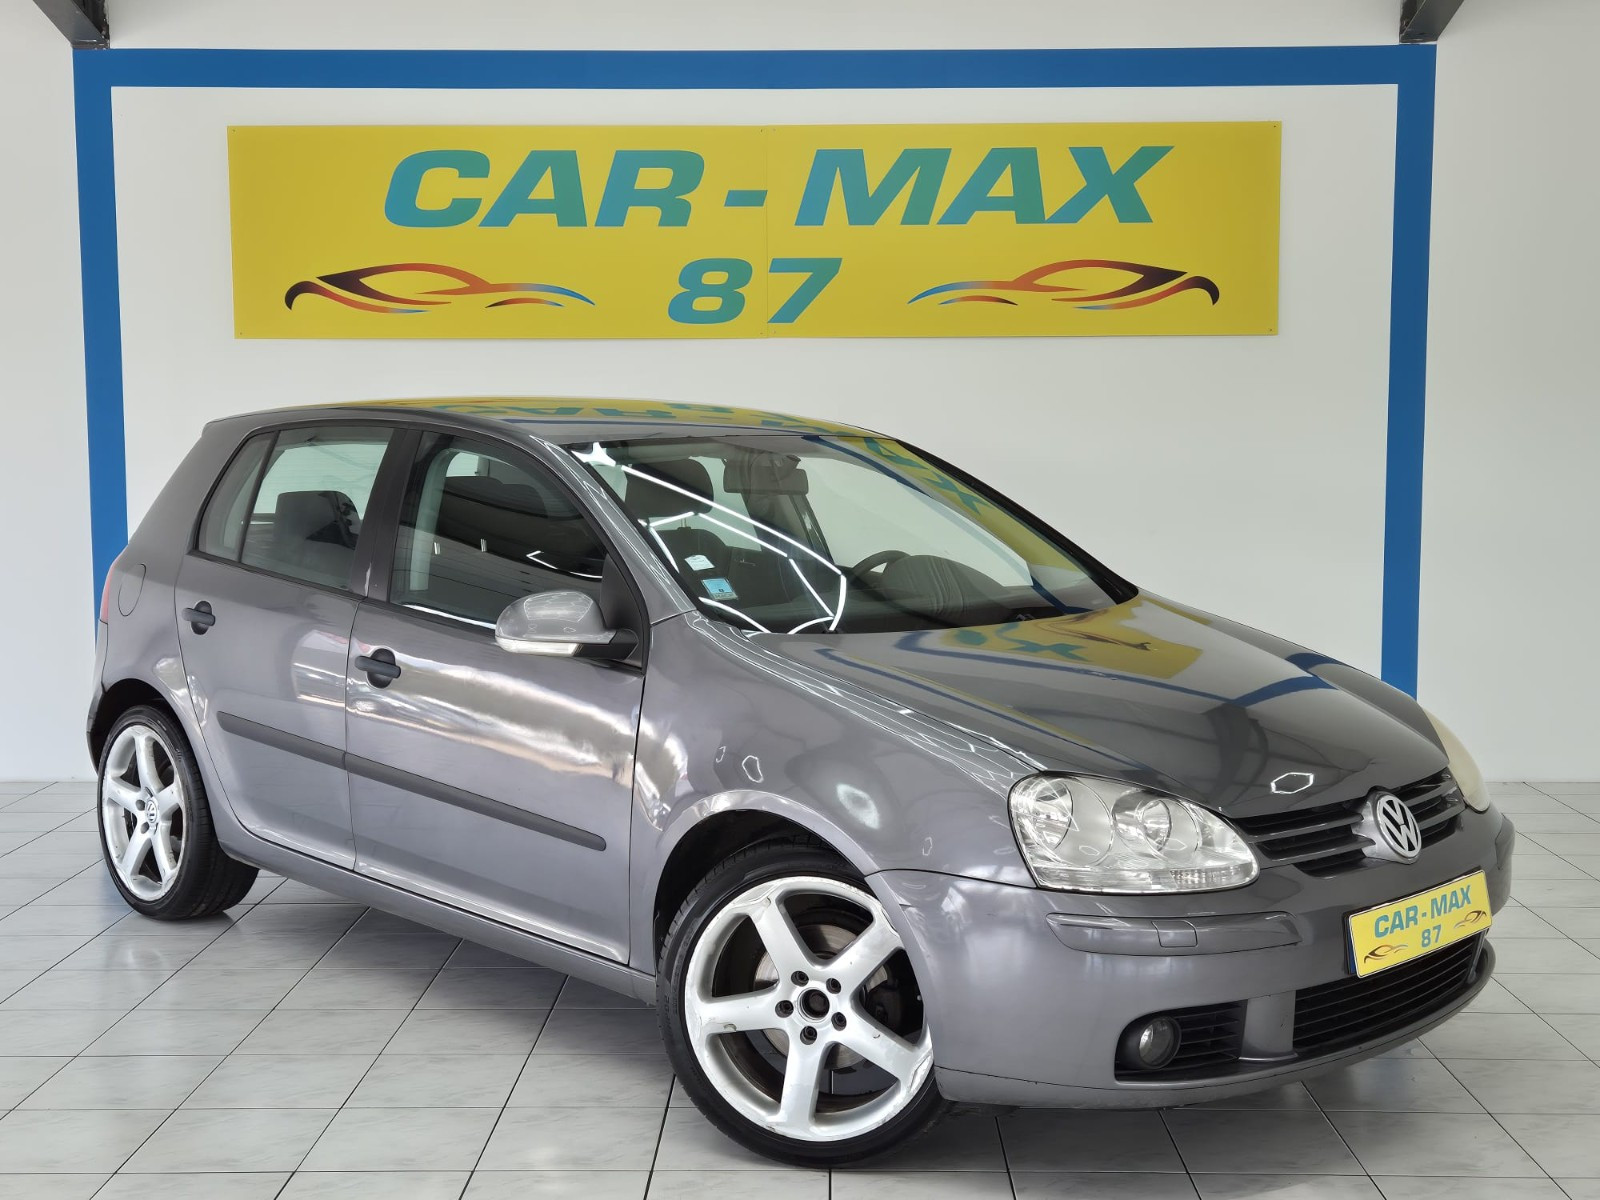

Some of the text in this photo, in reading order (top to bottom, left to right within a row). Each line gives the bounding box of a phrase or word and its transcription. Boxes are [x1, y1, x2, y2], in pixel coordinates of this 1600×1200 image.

[384, 149, 705, 229] CAR
[794, 145, 1173, 227] MAX
[668, 257, 842, 325] 87
[1374, 904, 1419, 939] CAR
[1430, 884, 1472, 920] MAX
[1421, 924, 1442, 949] 87
